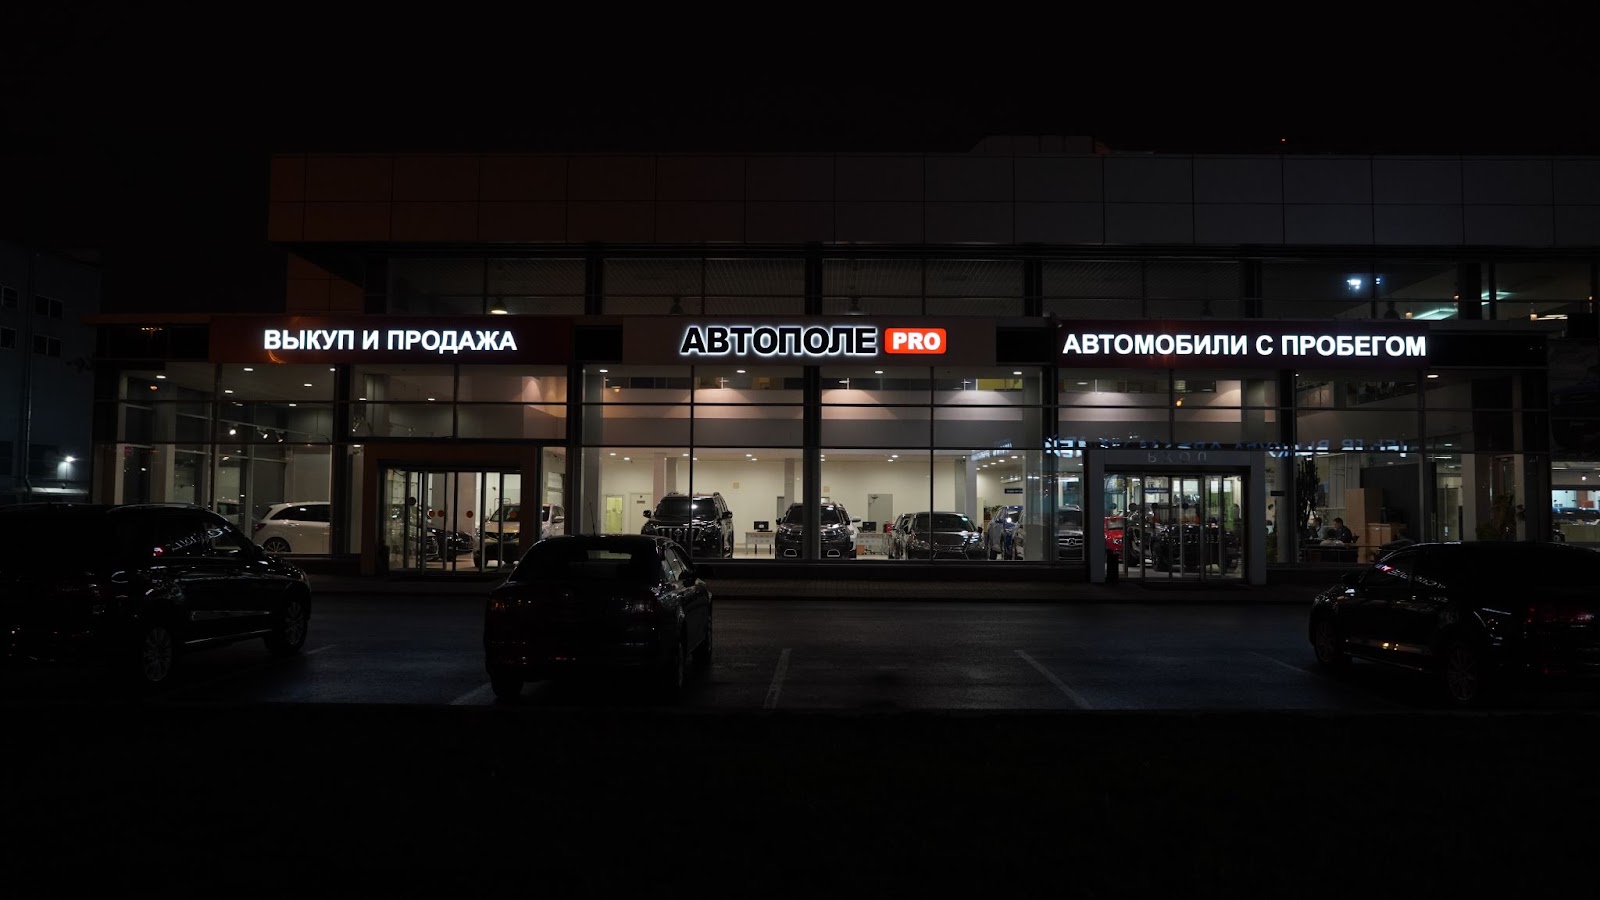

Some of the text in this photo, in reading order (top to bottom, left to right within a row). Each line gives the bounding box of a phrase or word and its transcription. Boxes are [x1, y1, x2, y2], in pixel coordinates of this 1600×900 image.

[264, 329, 518, 355] ВЫКУП И ПРОДАЖА
[680, 327, 877, 355] АВТОПОЛЕ
[893, 332, 941, 351] PRO
[1062, 333, 1426, 357] АВТОМОБИЛИ С ПРОБЕГОМ
